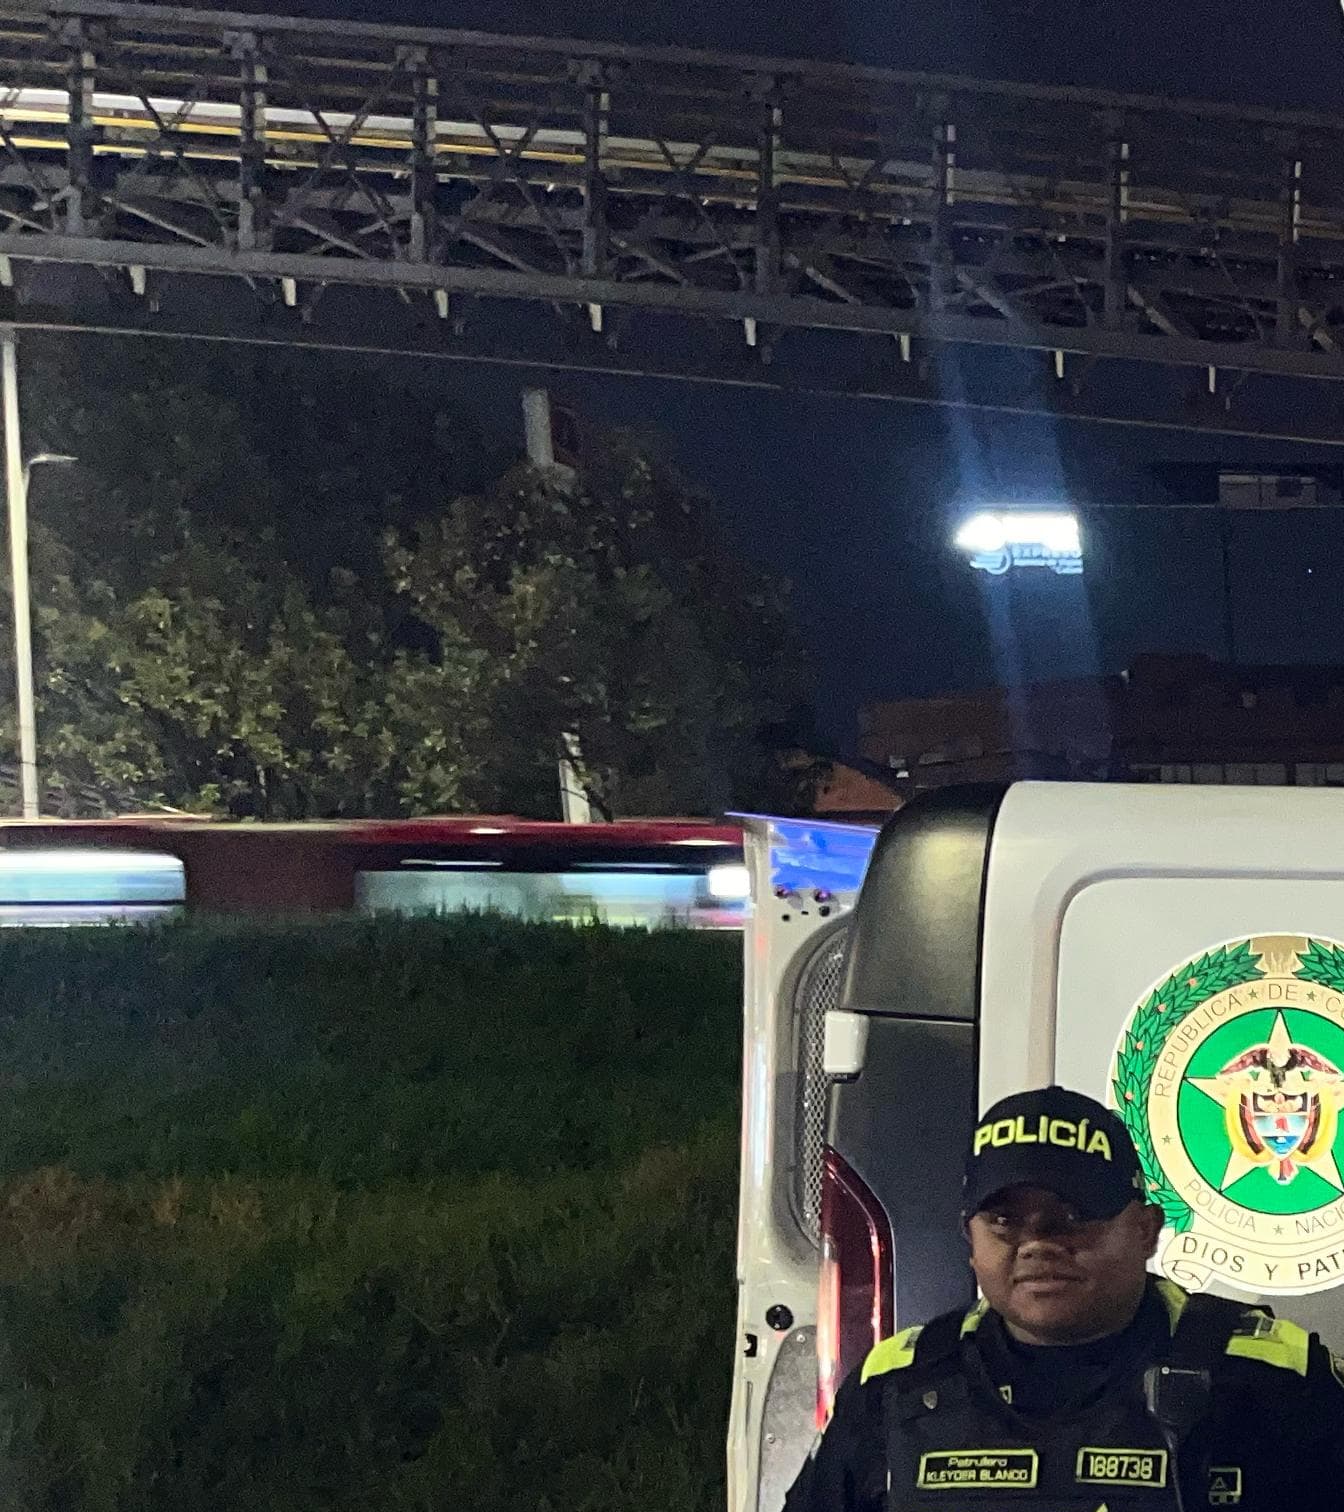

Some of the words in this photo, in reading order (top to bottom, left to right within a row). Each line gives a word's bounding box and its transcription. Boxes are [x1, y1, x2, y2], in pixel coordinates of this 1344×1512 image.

[1155, 990, 1243, 1097] REPUBLICA
[1268, 982, 1299, 1001] DE
[973, 1115, 1112, 1161] POLICÍA
[1183, 1180, 1257, 1233] POLICIA
[1182, 1236, 1245, 1273] DIOS
[1265, 1262, 1277, 1281] Y
[980, 1469, 1028, 1481] BLANCO
[1089, 1455, 1153, 1480] 188738
